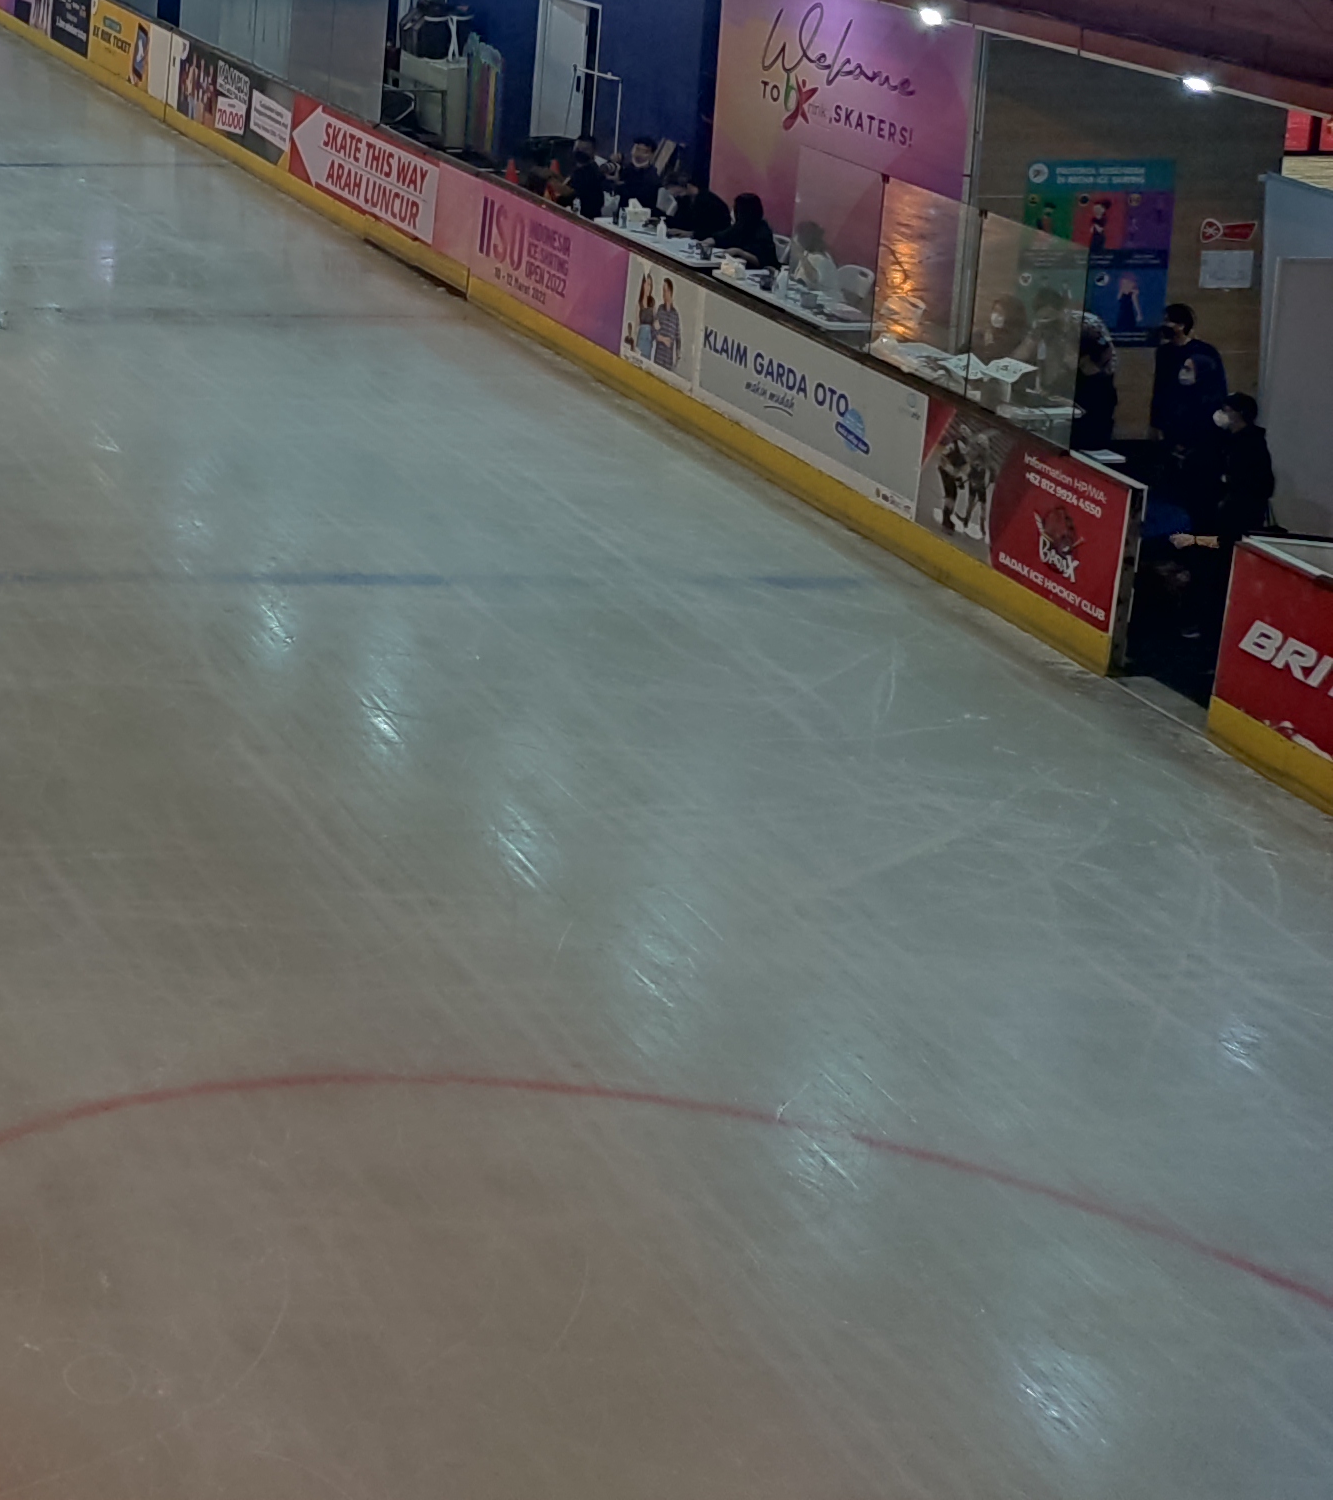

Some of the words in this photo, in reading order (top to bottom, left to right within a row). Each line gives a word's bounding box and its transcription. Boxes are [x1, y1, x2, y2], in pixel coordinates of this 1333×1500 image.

[761, 2, 916, 96] Welcome
[217, 108, 244, 131] 70.000
[761, 80, 780, 102] TO
[323, 122, 363, 163] SKATE
[365, 141, 394, 178] THIS
[396, 155, 428, 194] WAY
[325, 160, 363, 200] ARAH
[364, 177, 420, 230] LUNCUR
[525, 261, 545, 286] OPEN
[545, 271, 567, 298] 2022
[703, 326, 748, 369] KLAIM
[753, 351, 808, 400] GARDA
[814, 382, 850, 418] OTO
[1023, 452, 1074, 487] Information
[998, 552, 1029, 577] BADAX
[1030, 569, 1044, 586] ICE
[1044, 576, 1081, 606] HOCKEY
[1081, 596, 1106, 621] CLUB
[1238, 620, 1333, 697] BRI
